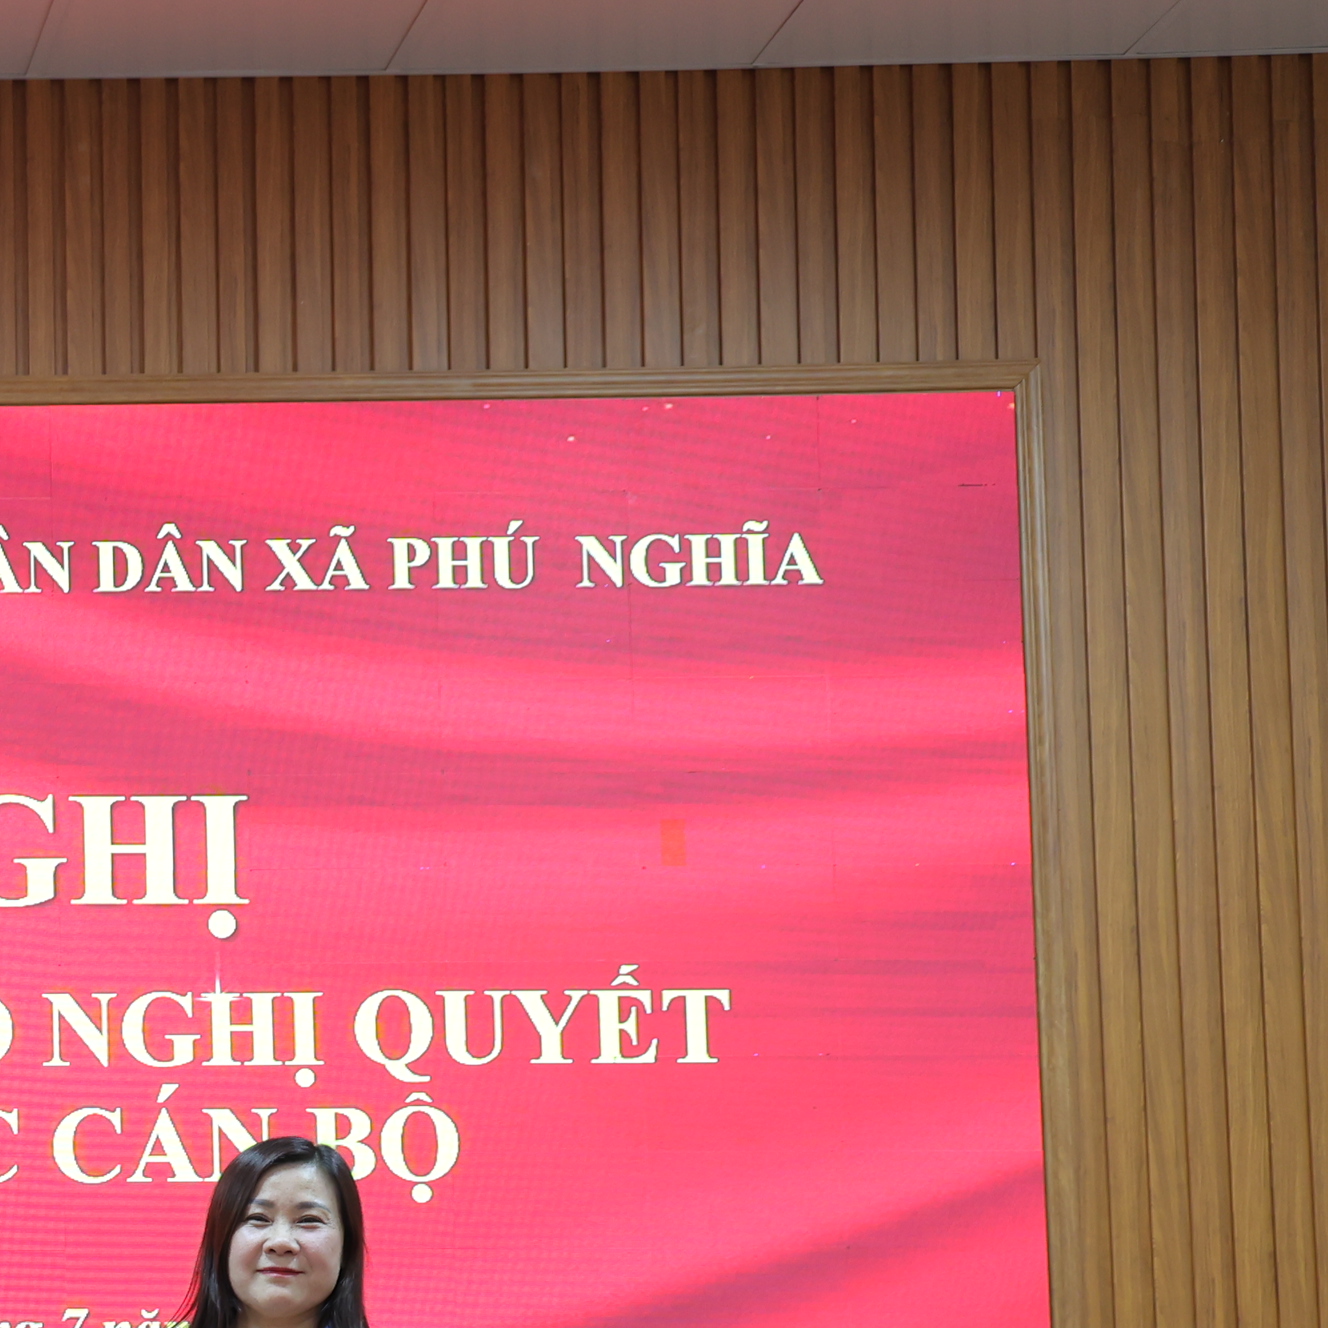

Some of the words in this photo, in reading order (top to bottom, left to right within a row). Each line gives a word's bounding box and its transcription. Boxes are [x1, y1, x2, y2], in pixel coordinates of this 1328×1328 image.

[91, 523, 247, 593] DÂN
[265, 525, 370, 592] XÃ
[386, 520, 540, 590] PHÚ
[574, 520, 824, 588] NGHĨA
[41, 988, 325, 1088] NGHỊ
[354, 964, 731, 1084] QUYẾT
